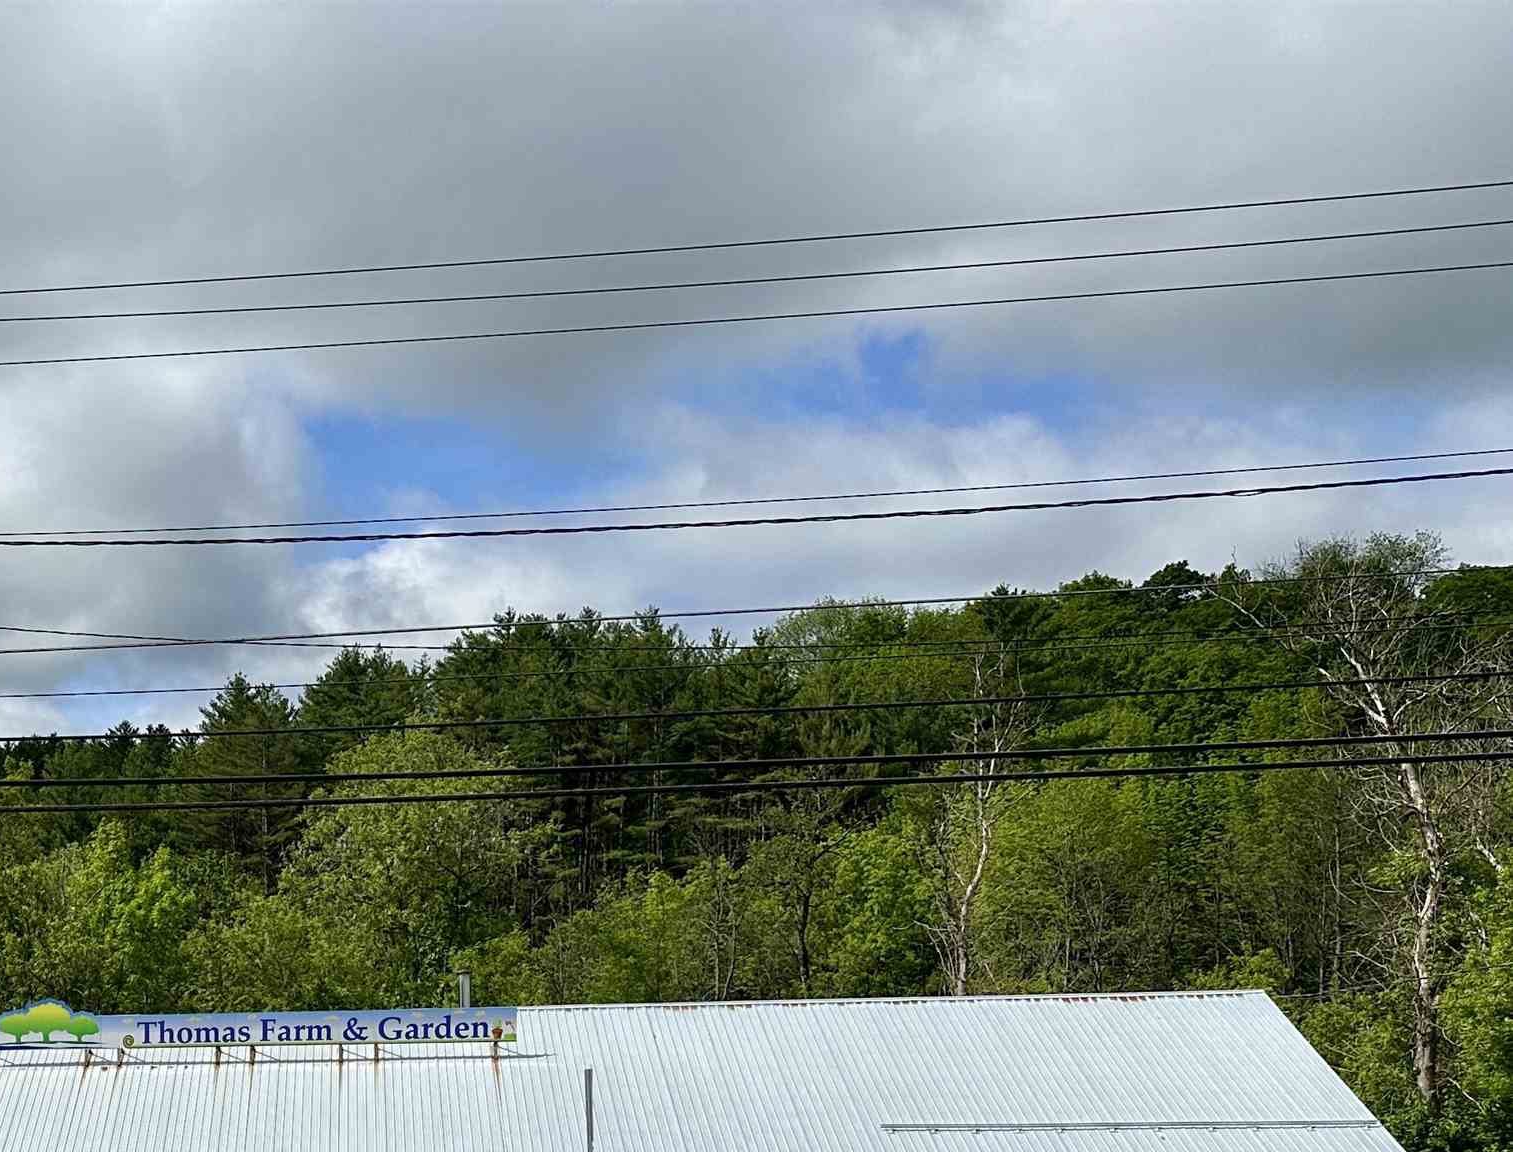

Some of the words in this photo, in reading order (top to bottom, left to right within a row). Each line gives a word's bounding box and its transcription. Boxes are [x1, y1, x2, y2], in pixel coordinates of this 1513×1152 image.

[137, 1020, 250, 1044] Thomas
[259, 1018, 333, 1042] Farm
[342, 1017, 368, 1041] &
[378, 1015, 490, 1040] Garden
